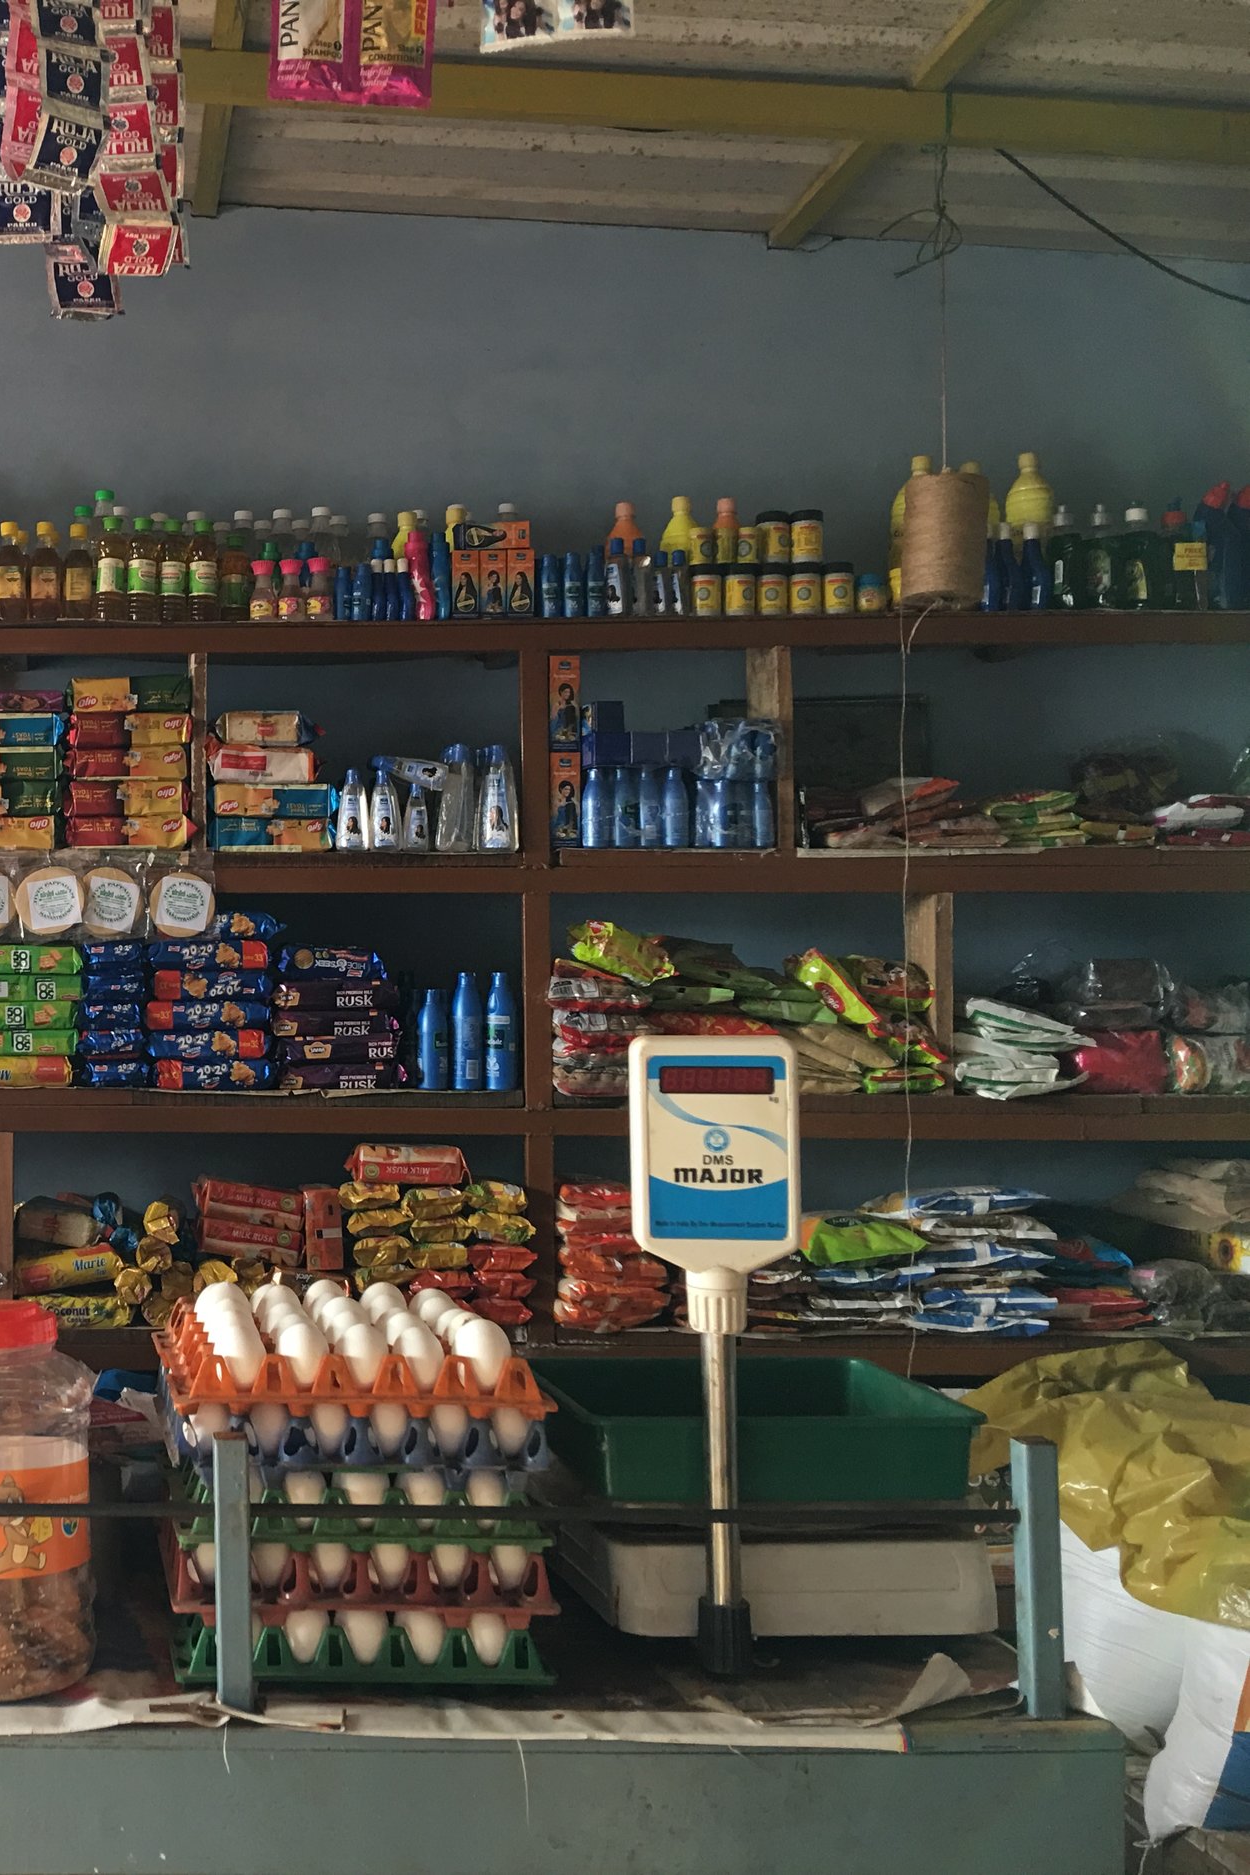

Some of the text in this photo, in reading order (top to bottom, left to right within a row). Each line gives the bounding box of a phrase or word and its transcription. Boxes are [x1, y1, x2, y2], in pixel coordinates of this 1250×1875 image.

[303, 48, 342, 58] SHAMPOO
[50, 119, 98, 144] ROJA
[56, 135, 87, 151] GOLD
[4, 195, 38, 205] GOLD
[124, 254, 155, 264] GOLD
[113, 262, 159, 276] ROJA
[13, 951, 28, 961] 50
[337, 994, 373, 1007] RUSK
[7, 1007, 22, 1016] 50
[7, 1015, 22, 1025] 50
[334, 1026, 370, 1036] RUSK
[340, 1080, 376, 1089] RUSK
[702, 1155, 734, 1165] DMS
[386, 1166, 430, 1175] MILK RUSK
[674, 1168, 763, 1184] MAJOR
[255, 1197, 277, 1208] RUSK
[232, 1229, 274, 1243] MILK RUSK
[73, 1257, 106, 1273] Marie
[47, 1303, 90, 1317] Coconut
